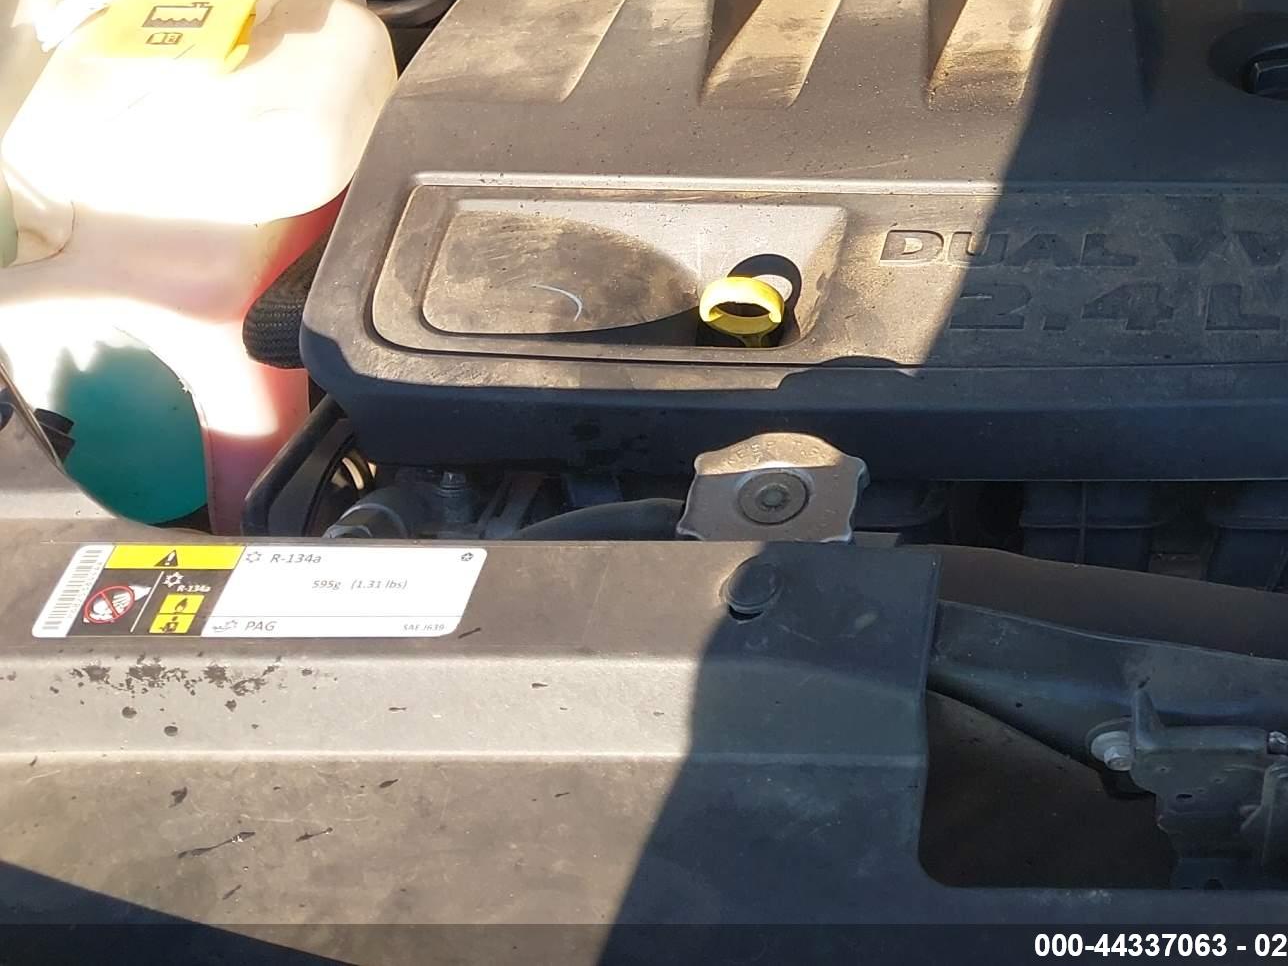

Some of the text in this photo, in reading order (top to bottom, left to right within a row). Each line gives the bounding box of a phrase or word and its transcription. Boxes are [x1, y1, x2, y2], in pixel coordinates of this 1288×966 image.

[879, 229, 1138, 267] DUAL
[949, 282, 1282, 331] 2.4L
[270, 553, 322, 564] R-134a
[176, 585, 212, 593] R-134a
[311, 579, 408, 591] 595g (1.31 lbs)
[244, 620, 277, 632] PAG
[403, 623, 421, 631] SAE
